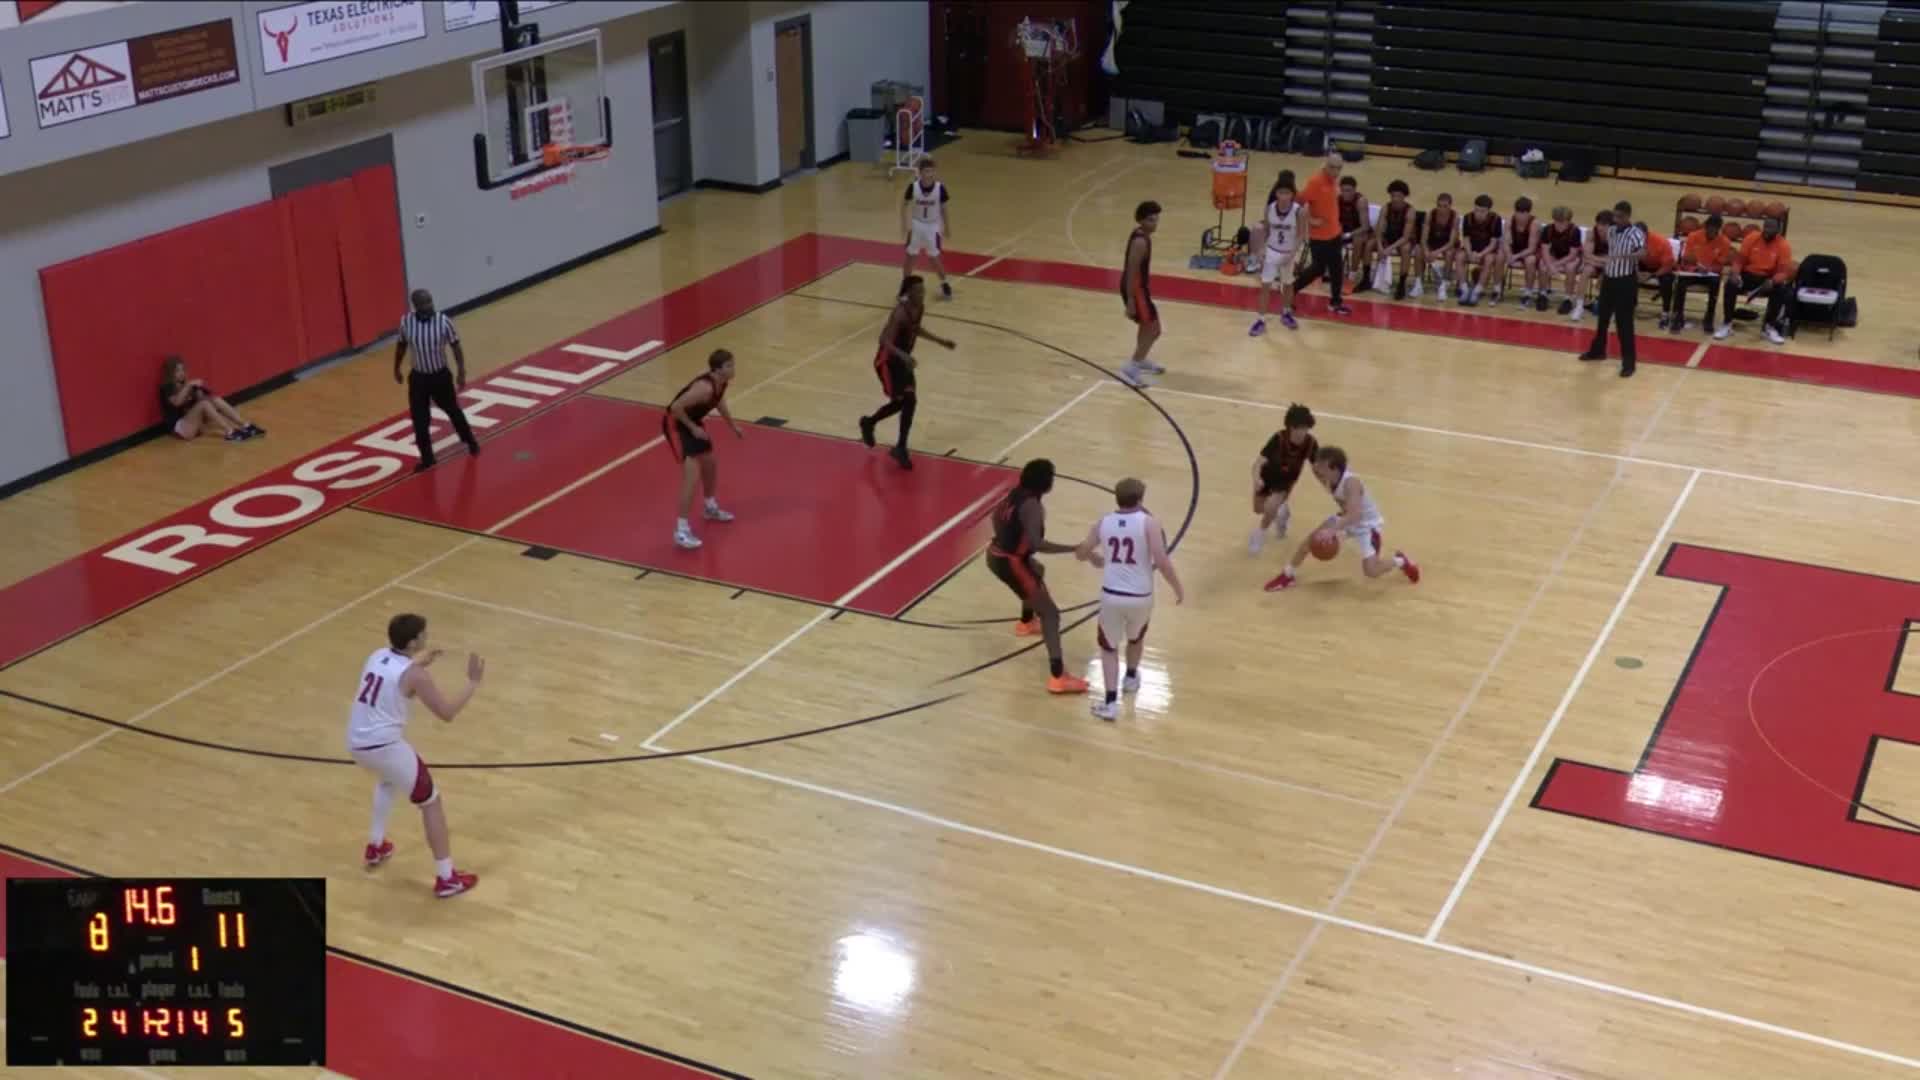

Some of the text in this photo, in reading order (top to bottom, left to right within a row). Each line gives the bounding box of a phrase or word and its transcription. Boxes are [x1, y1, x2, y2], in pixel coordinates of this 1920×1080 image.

[307, 1, 415, 26] TEXAS ELECTRIC
[332, 12, 395, 33] SOLUTIONS
[40, 90, 102, 119] MATT'S
[102, 339, 665, 576] ROSEHILL
[1107, 536, 1137, 565] 22
[357, 671, 384, 708] 21
